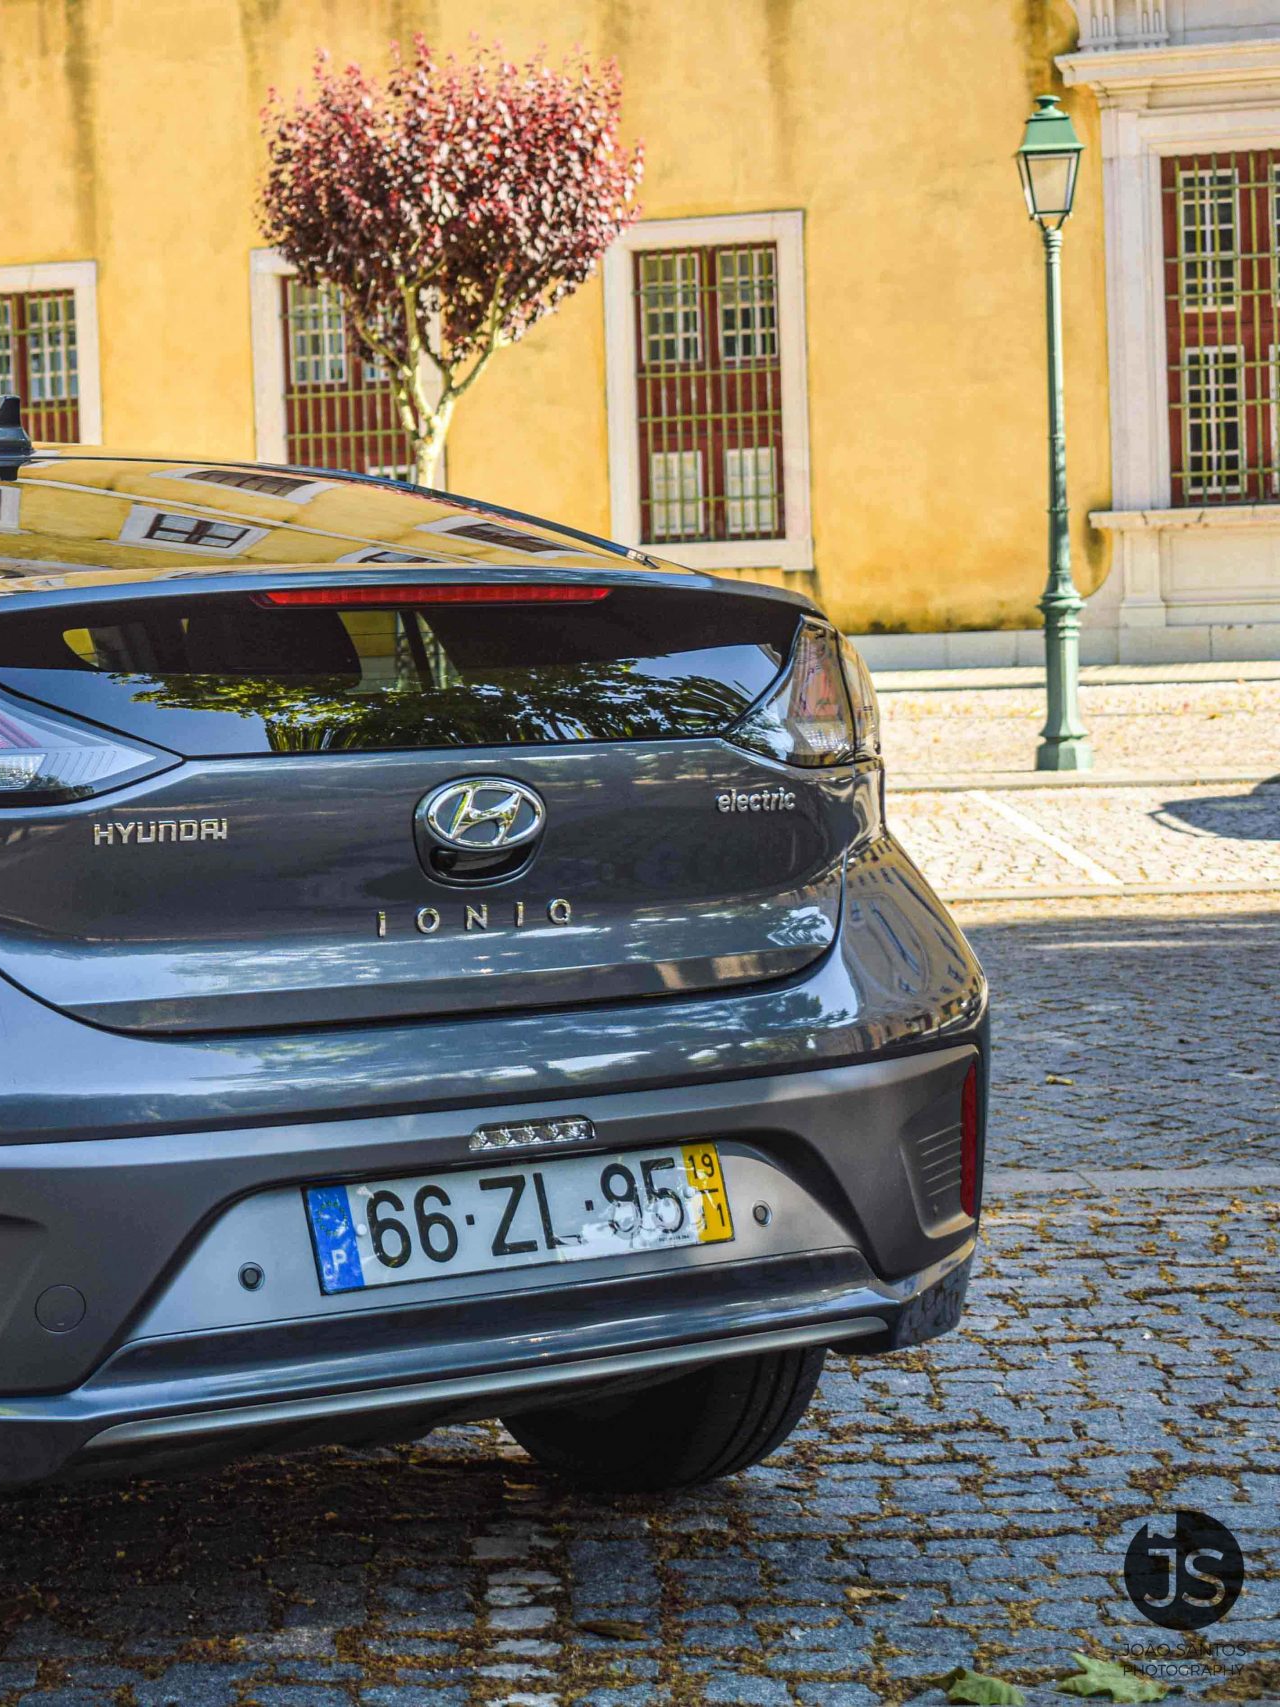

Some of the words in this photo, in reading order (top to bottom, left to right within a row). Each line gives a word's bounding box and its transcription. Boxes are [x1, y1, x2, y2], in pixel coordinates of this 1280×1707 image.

[717, 787, 796, 812] electric
[94, 818, 228, 846] HYUNDAI
[378, 898, 571, 937] IONIQ
[688, 1153, 715, 1180] 19
[331, 1248, 348, 1272] P
